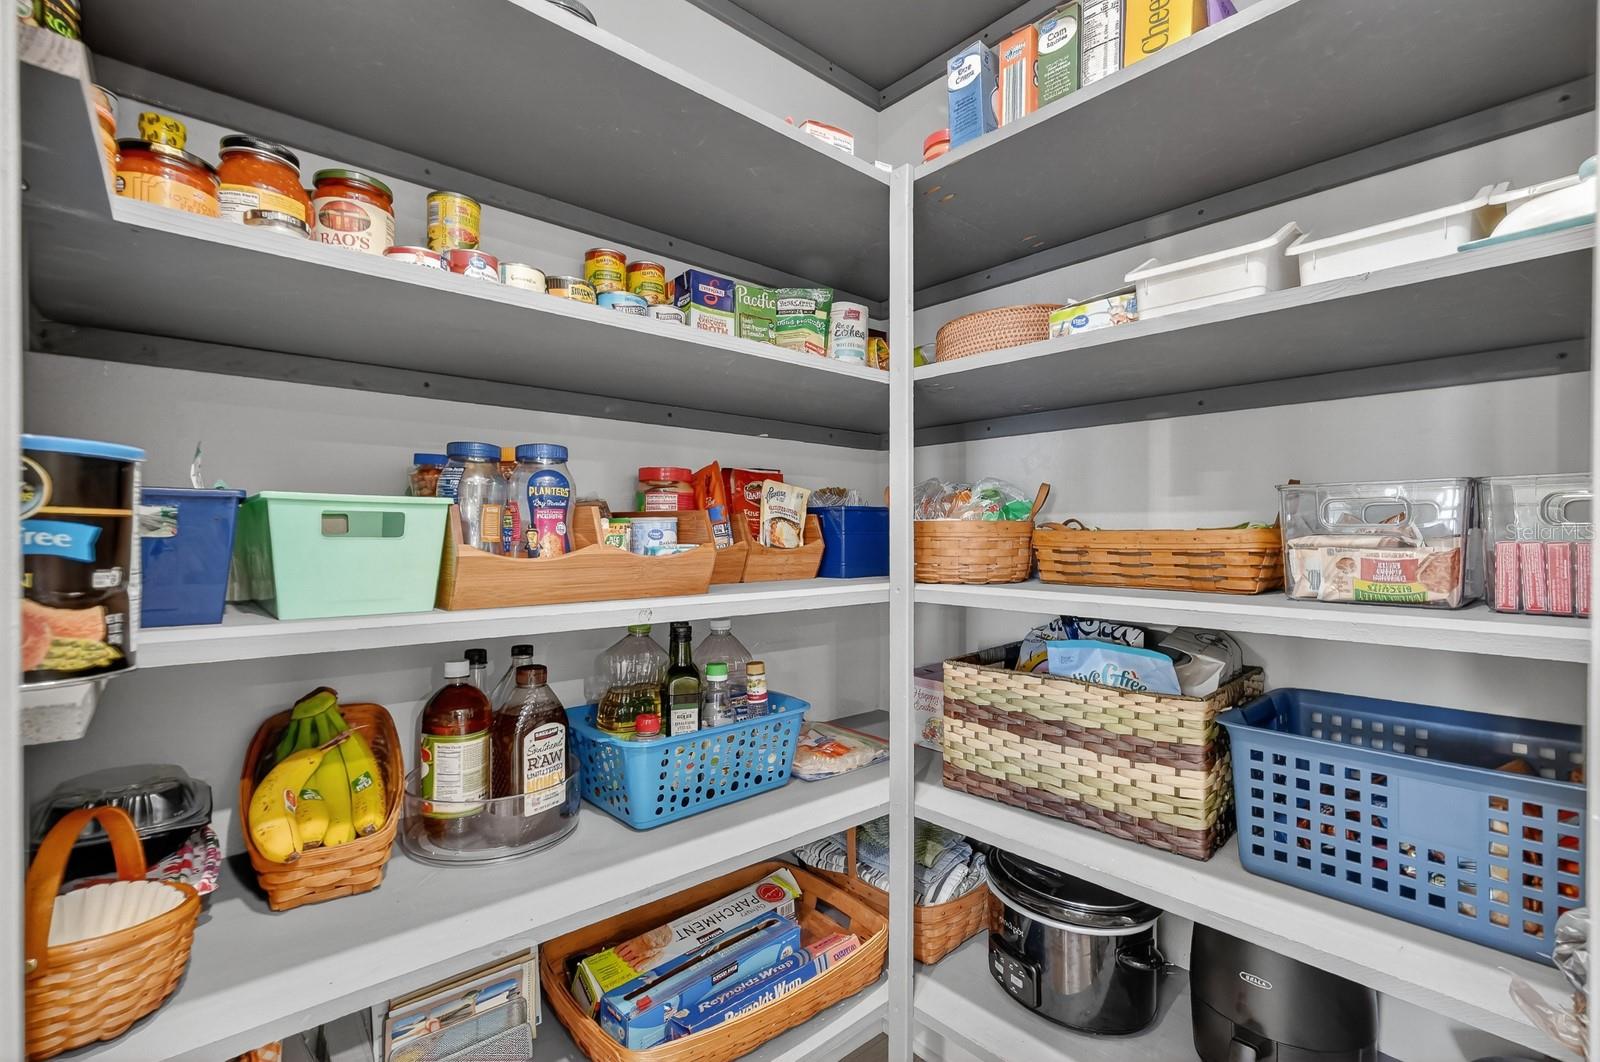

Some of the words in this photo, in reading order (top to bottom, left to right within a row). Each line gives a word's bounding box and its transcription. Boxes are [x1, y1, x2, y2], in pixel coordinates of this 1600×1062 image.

[320, 233, 370, 249] RAO'S
[735, 285, 776, 309] Pacific
[528, 486, 570, 498] PLANTERS
[527, 749, 564, 771] RAW
[675, 894, 760, 942] PARCHMENT
[697, 976, 759, 1013] Reynolds
[758, 959, 794, 982] Wrap
